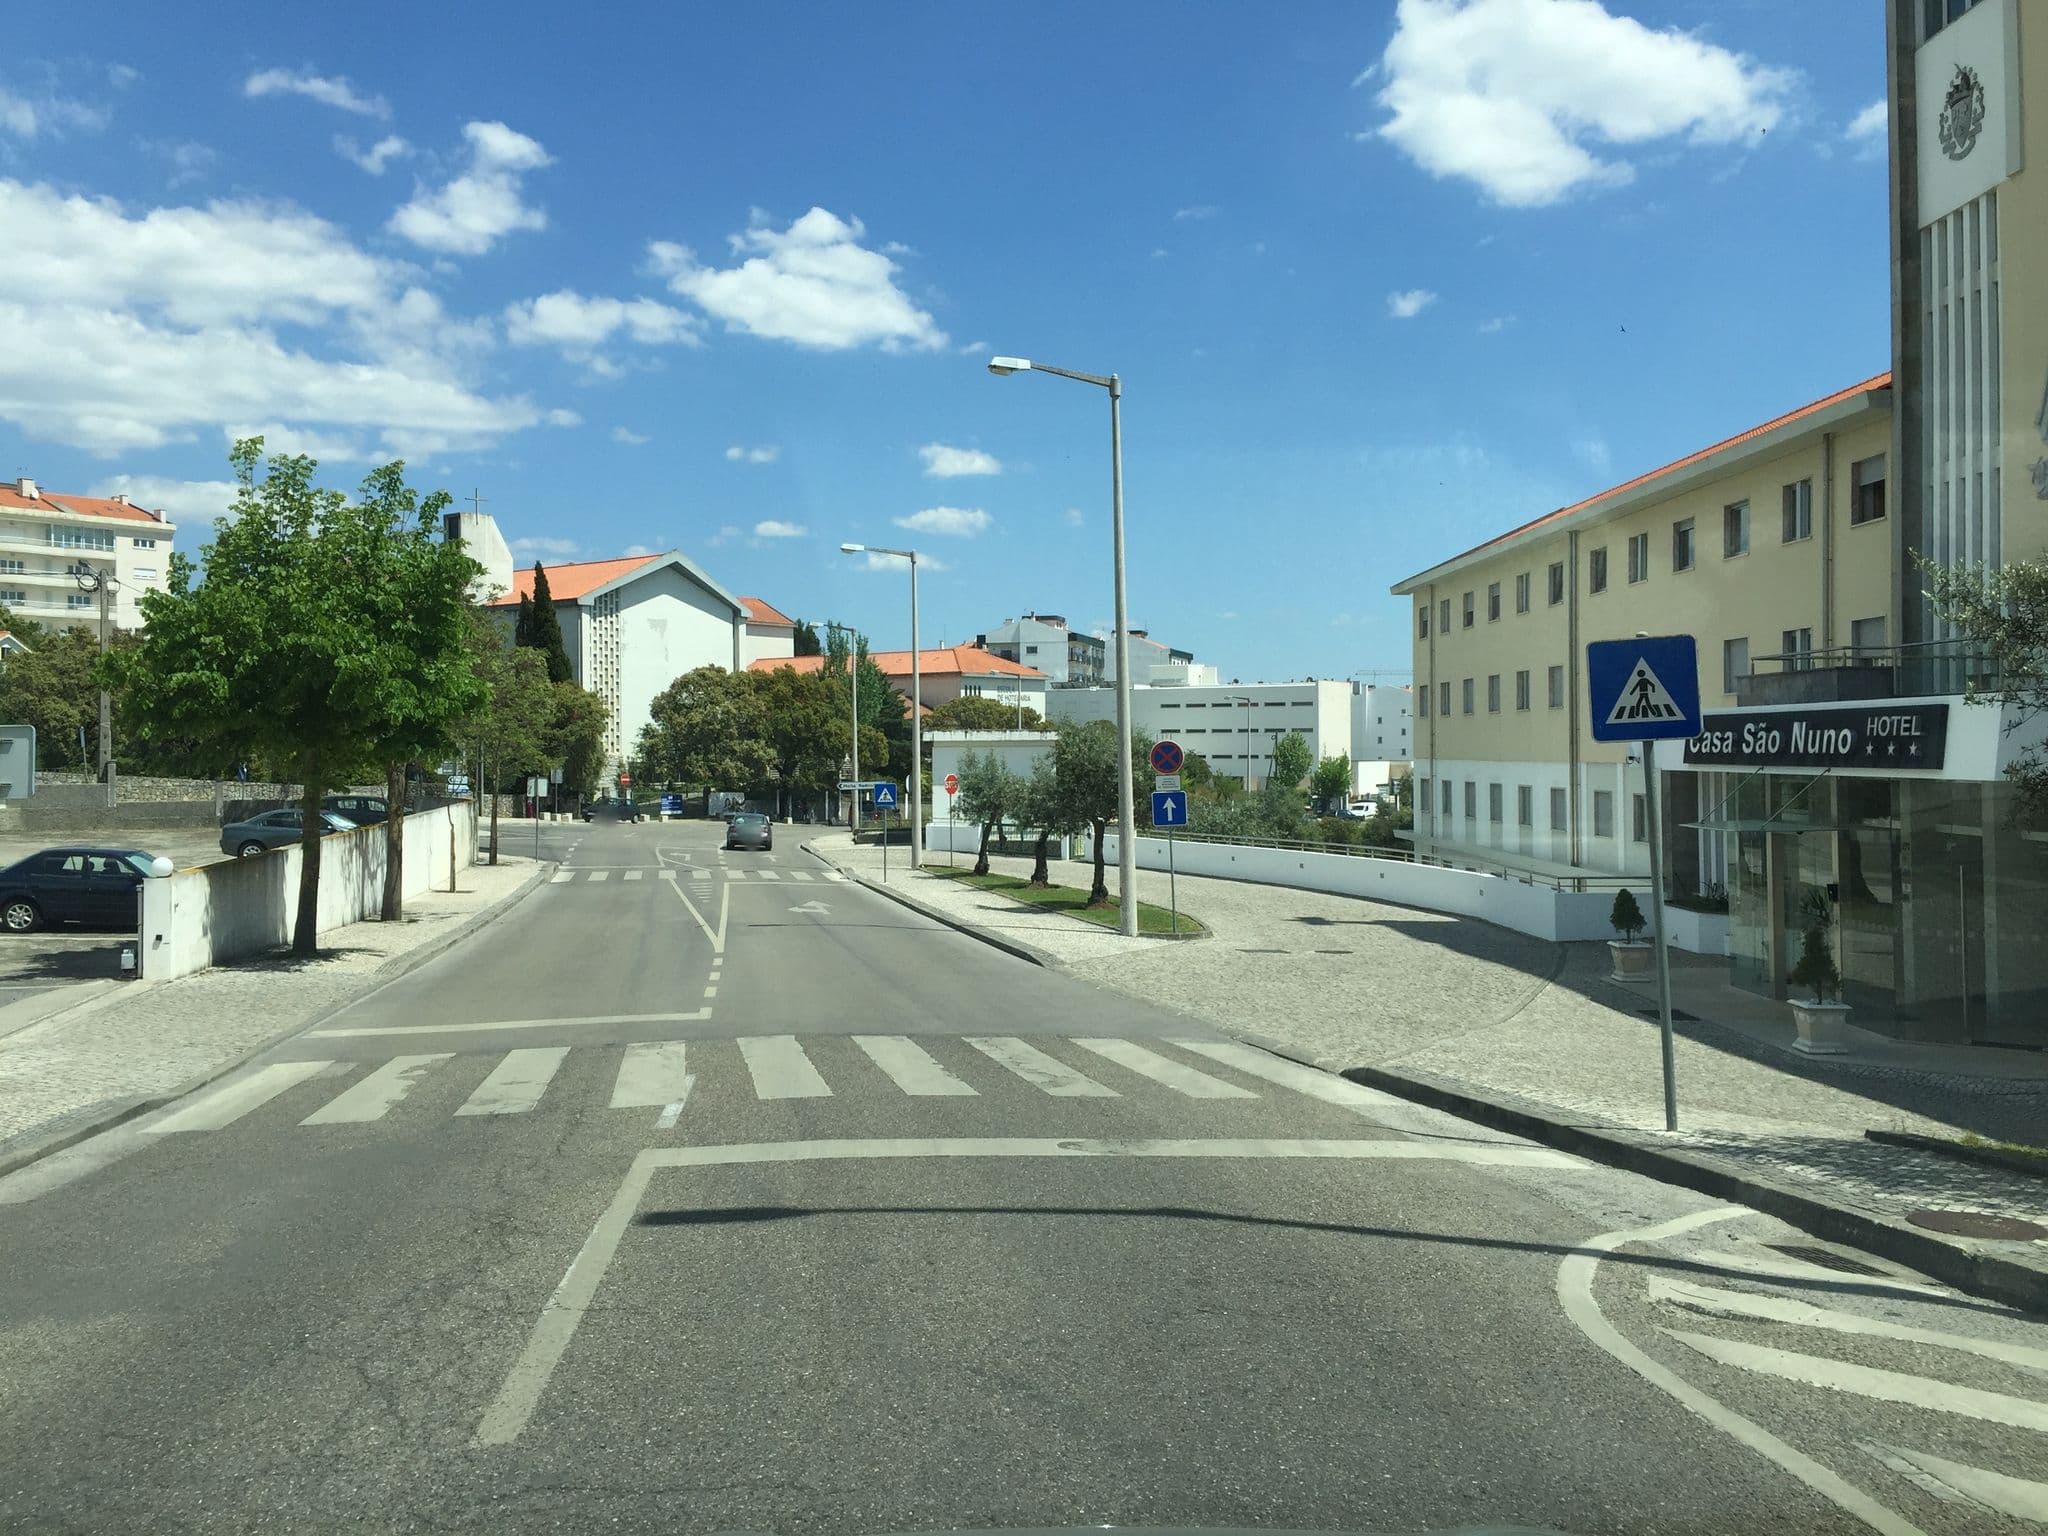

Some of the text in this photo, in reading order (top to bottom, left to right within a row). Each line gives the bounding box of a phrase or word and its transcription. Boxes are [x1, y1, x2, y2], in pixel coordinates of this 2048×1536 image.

[1689, 721, 1852, 755] Casa São Nuno
[1867, 715, 1921, 737] HOTEL
